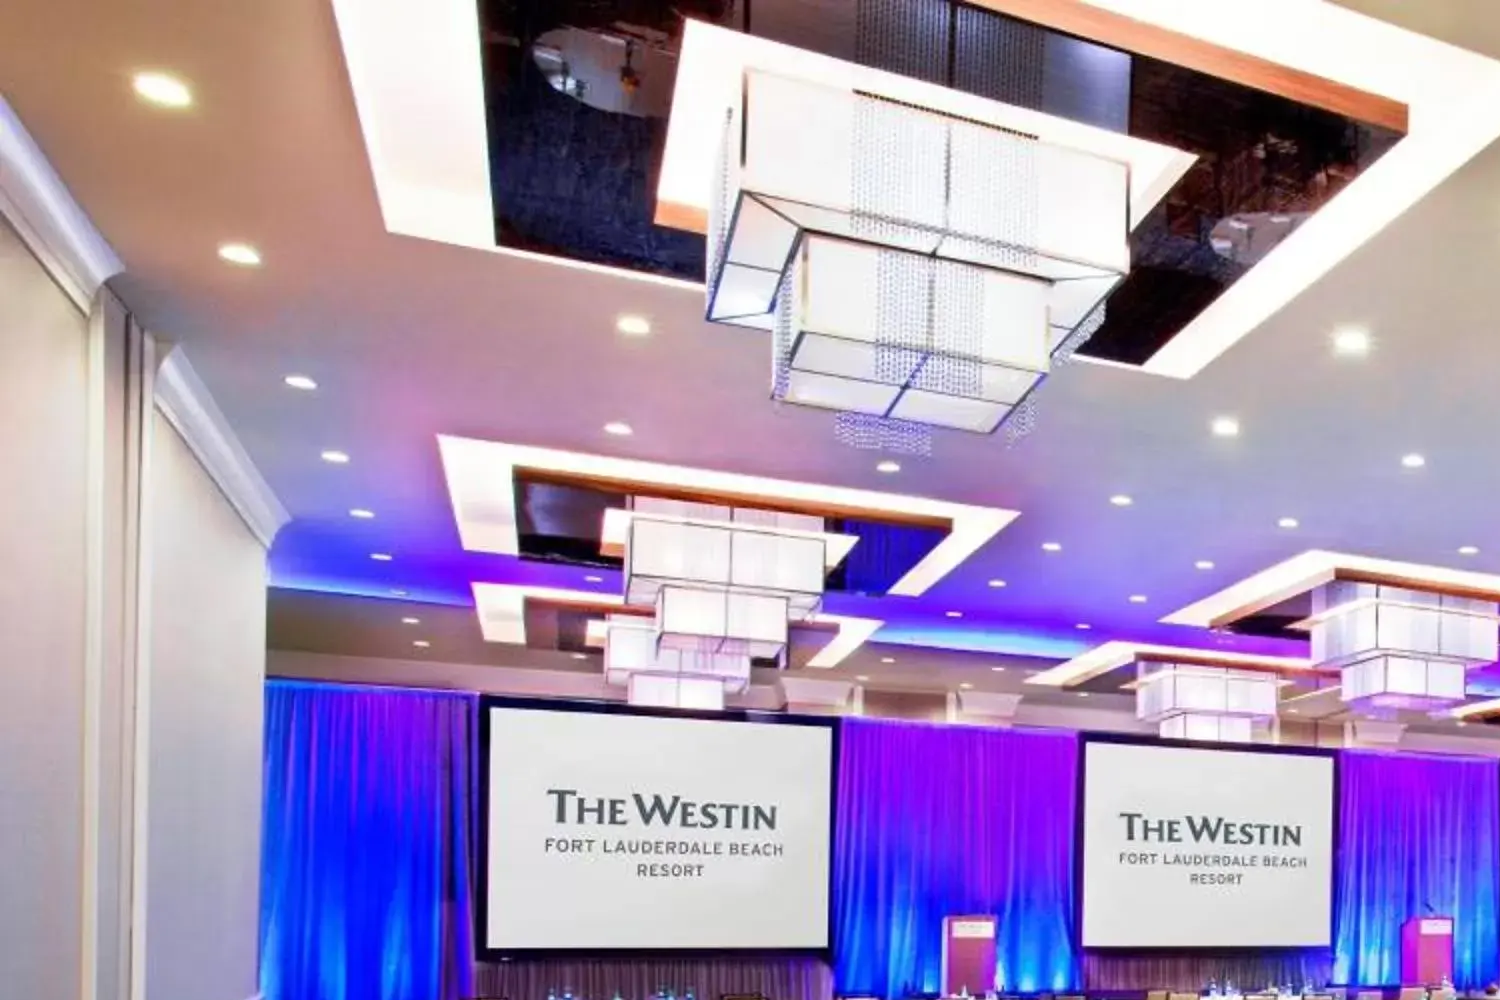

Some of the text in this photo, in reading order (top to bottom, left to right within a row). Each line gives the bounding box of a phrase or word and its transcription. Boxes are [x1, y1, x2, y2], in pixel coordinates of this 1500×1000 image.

[546, 789, 778, 831] THE WESTIN
[1119, 812, 1303, 847] THE WESTIN
[544, 838, 784, 857] FORT LAUDERDALE BEACH
[1119, 852, 1308, 868] FORT LAUDERDALE BEACH
[637, 863, 705, 877] RESORT
[1190, 873, 1244, 885] RESORT
